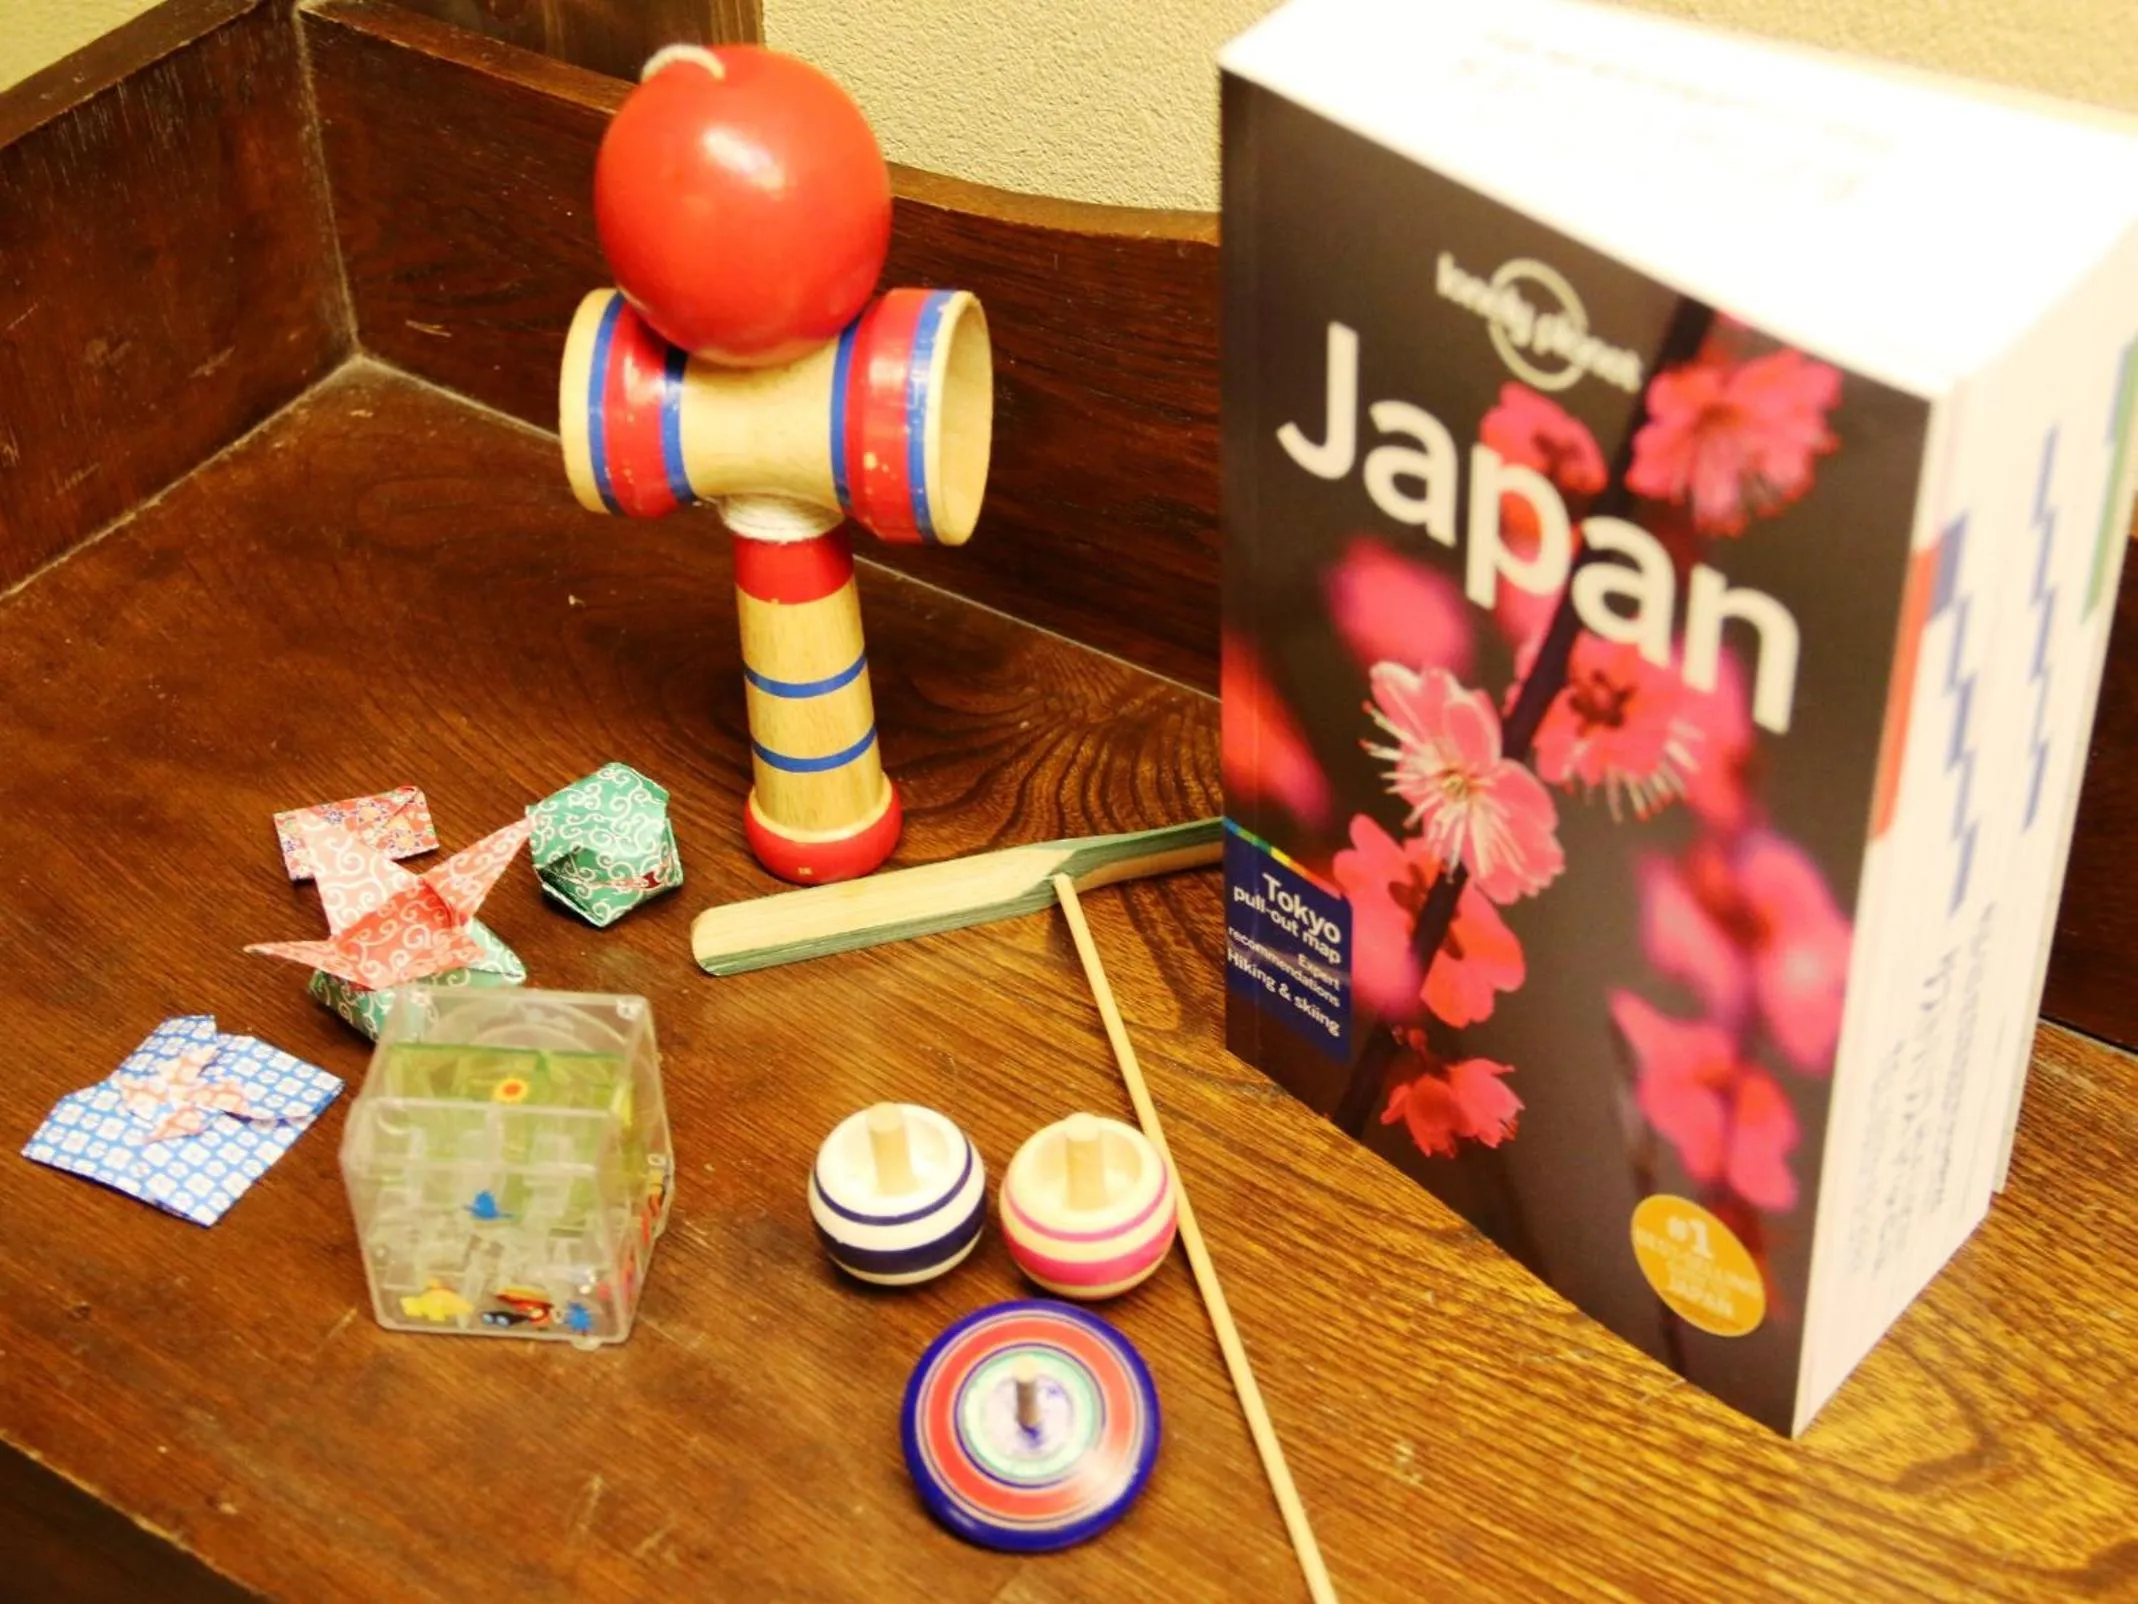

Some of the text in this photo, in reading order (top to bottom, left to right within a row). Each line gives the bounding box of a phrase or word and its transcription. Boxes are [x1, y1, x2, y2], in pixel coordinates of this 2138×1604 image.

[1276, 321, 1799, 735] Japan
[1233, 886, 1341, 965] pull-out map
[1263, 872, 1341, 943] Tokyo
[1227, 948, 1340, 1038] Hiking & skiing
[1228, 926, 1340, 1008] recommendations
[1298, 953, 1340, 991] Expert
